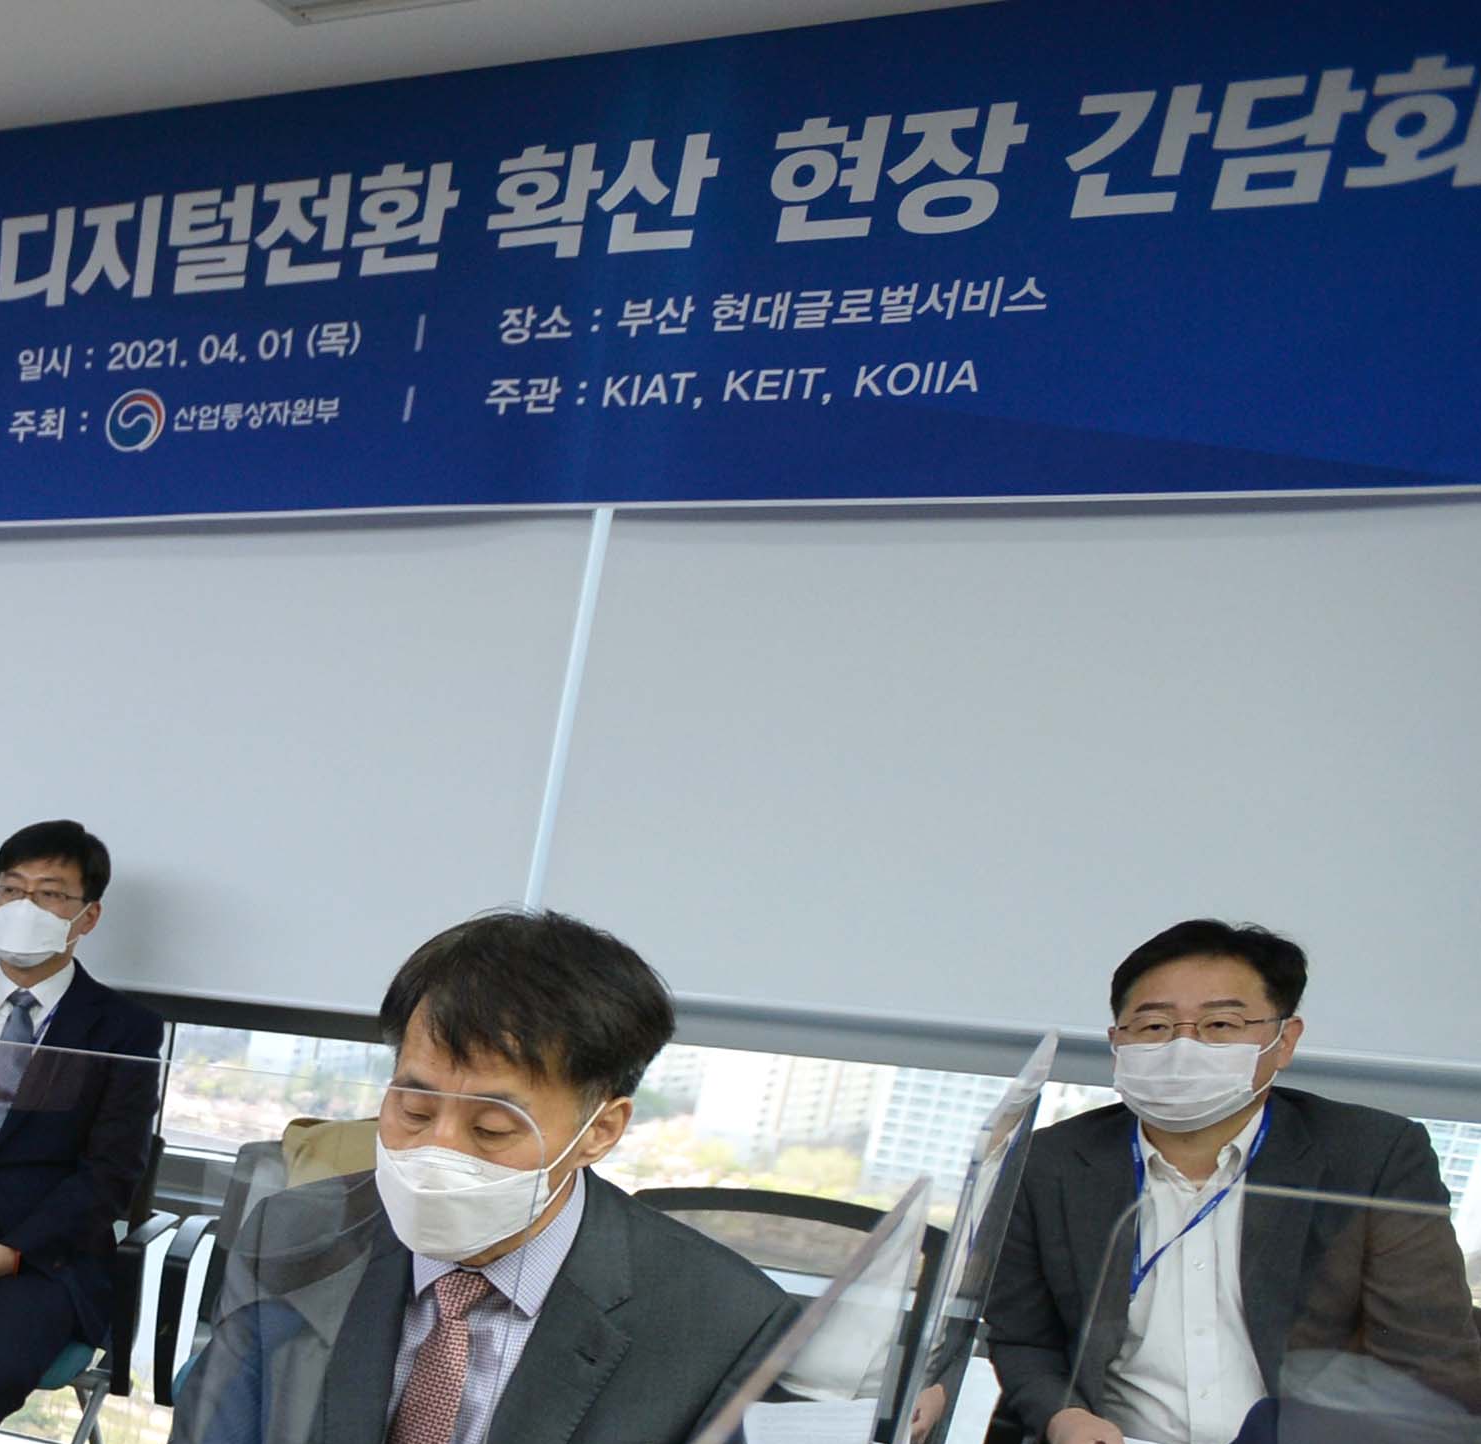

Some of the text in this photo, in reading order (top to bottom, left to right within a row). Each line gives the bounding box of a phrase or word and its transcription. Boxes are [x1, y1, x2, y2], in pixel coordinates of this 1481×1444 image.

[486, 132, 720, 259] 확산
[770, 101, 1030, 243] 현장
[1065, 56, 1481, 219] 간담회
[499, 305, 573, 345] 장소
[617, 295, 696, 338] 부산
[712, 276, 1047, 332] 현대글로벌서비스
[18, 344, 72, 382] 일시
[106, 337, 188, 371] 2021.
[198, 332, 247, 365] 04.
[258, 328, 294, 361] 01
[306, 321, 362, 358] (목)
[484, 376, 562, 416] 주관
[602, 371, 702, 409] KIAT,
[723, 367, 832, 406] KEIT,
[853, 359, 978, 398] KOIIA
[8, 406, 66, 443] 주최
[173, 397, 340, 432] 산업통상자원부
